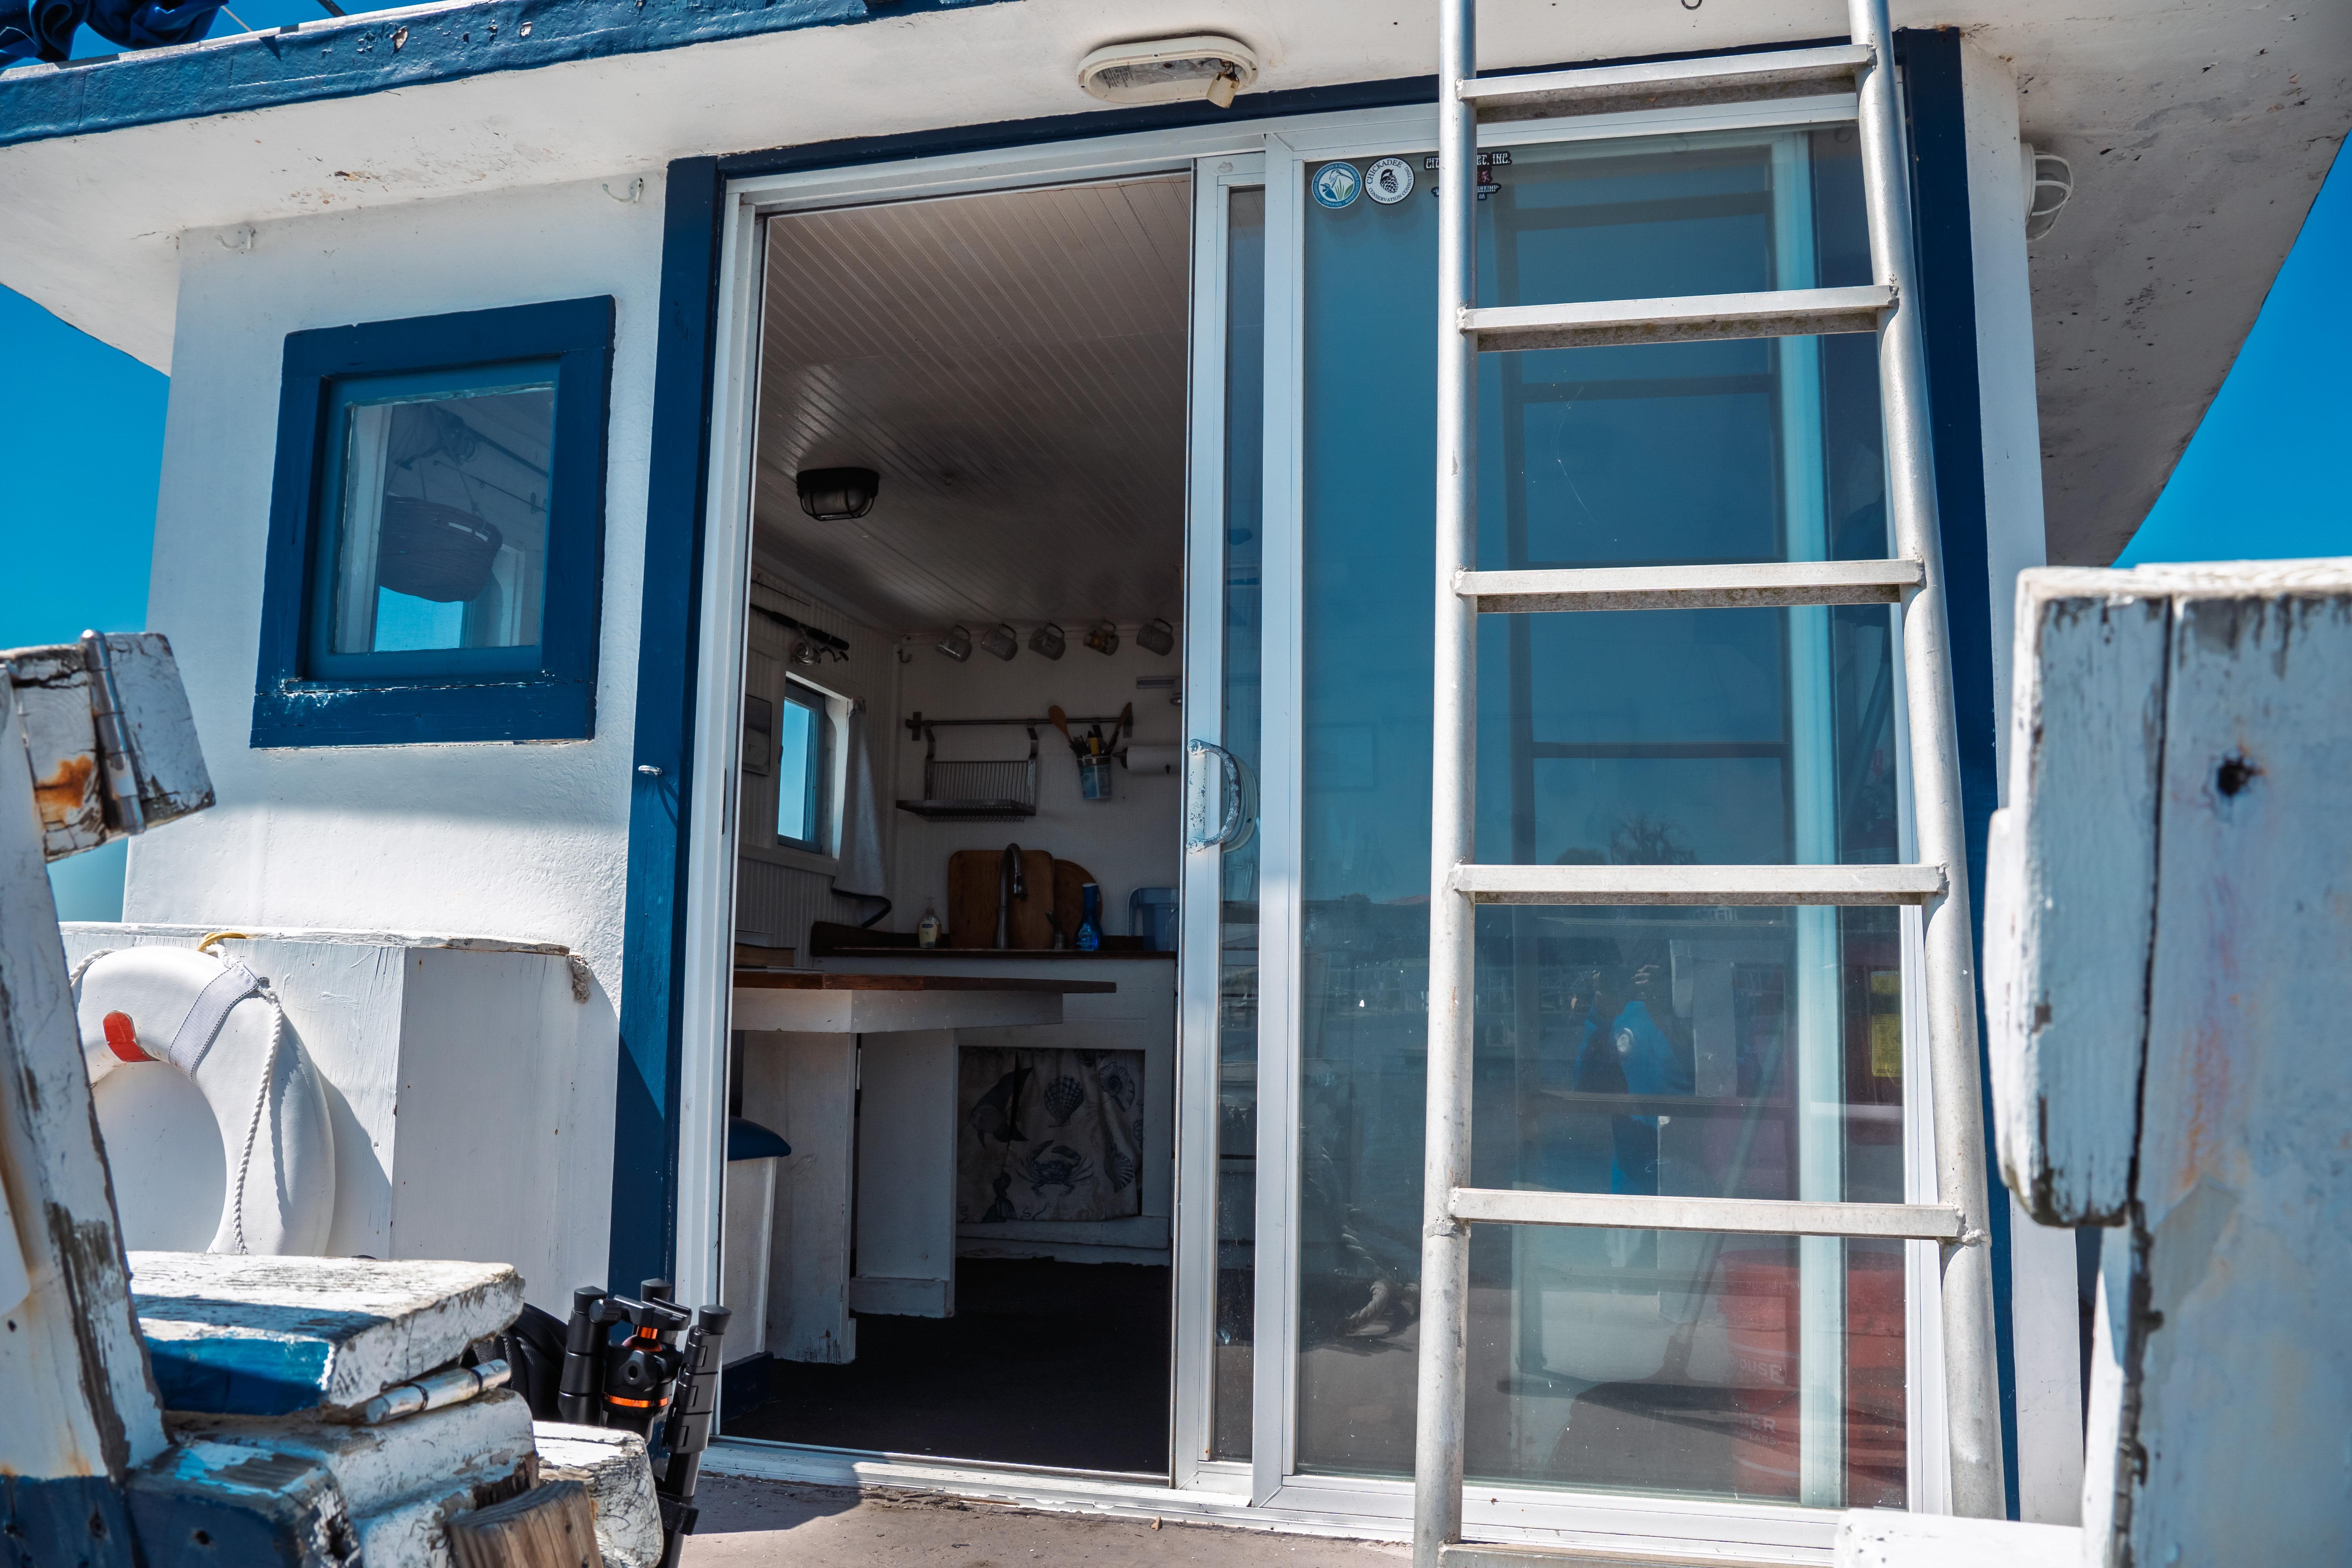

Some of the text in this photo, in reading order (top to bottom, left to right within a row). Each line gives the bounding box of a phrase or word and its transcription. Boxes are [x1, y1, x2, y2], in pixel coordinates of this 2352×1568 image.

[1493, 153, 1510, 164] INC.
[1316, 165, 1334, 182] AWARENESS
[1339, 164, 1359, 180] RESPONSIBLE
[1367, 160, 1403, 184] CHICKADEE
[1345, 181, 1359, 203] ECOTOURISM
[1368, 167, 1412, 202] CONSERVATION CONSULTING
